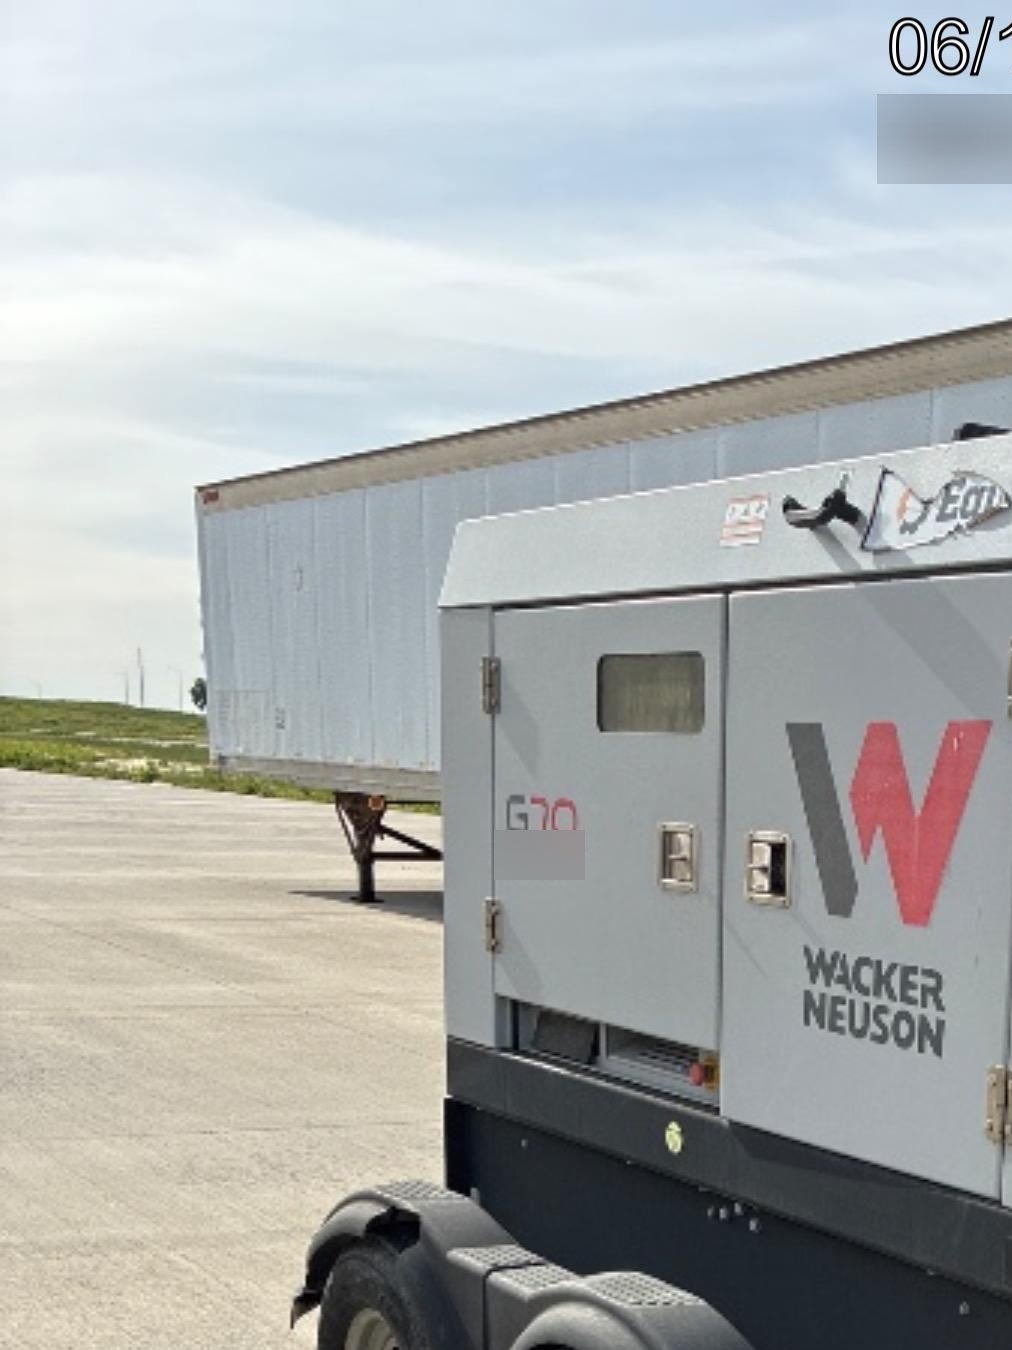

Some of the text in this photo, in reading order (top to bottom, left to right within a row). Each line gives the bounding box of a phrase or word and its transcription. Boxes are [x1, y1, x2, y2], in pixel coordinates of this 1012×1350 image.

[506, 794, 577, 831] G70
[803, 944, 945, 1012] WACKER
[803, 989, 946, 1059] NEUSON
